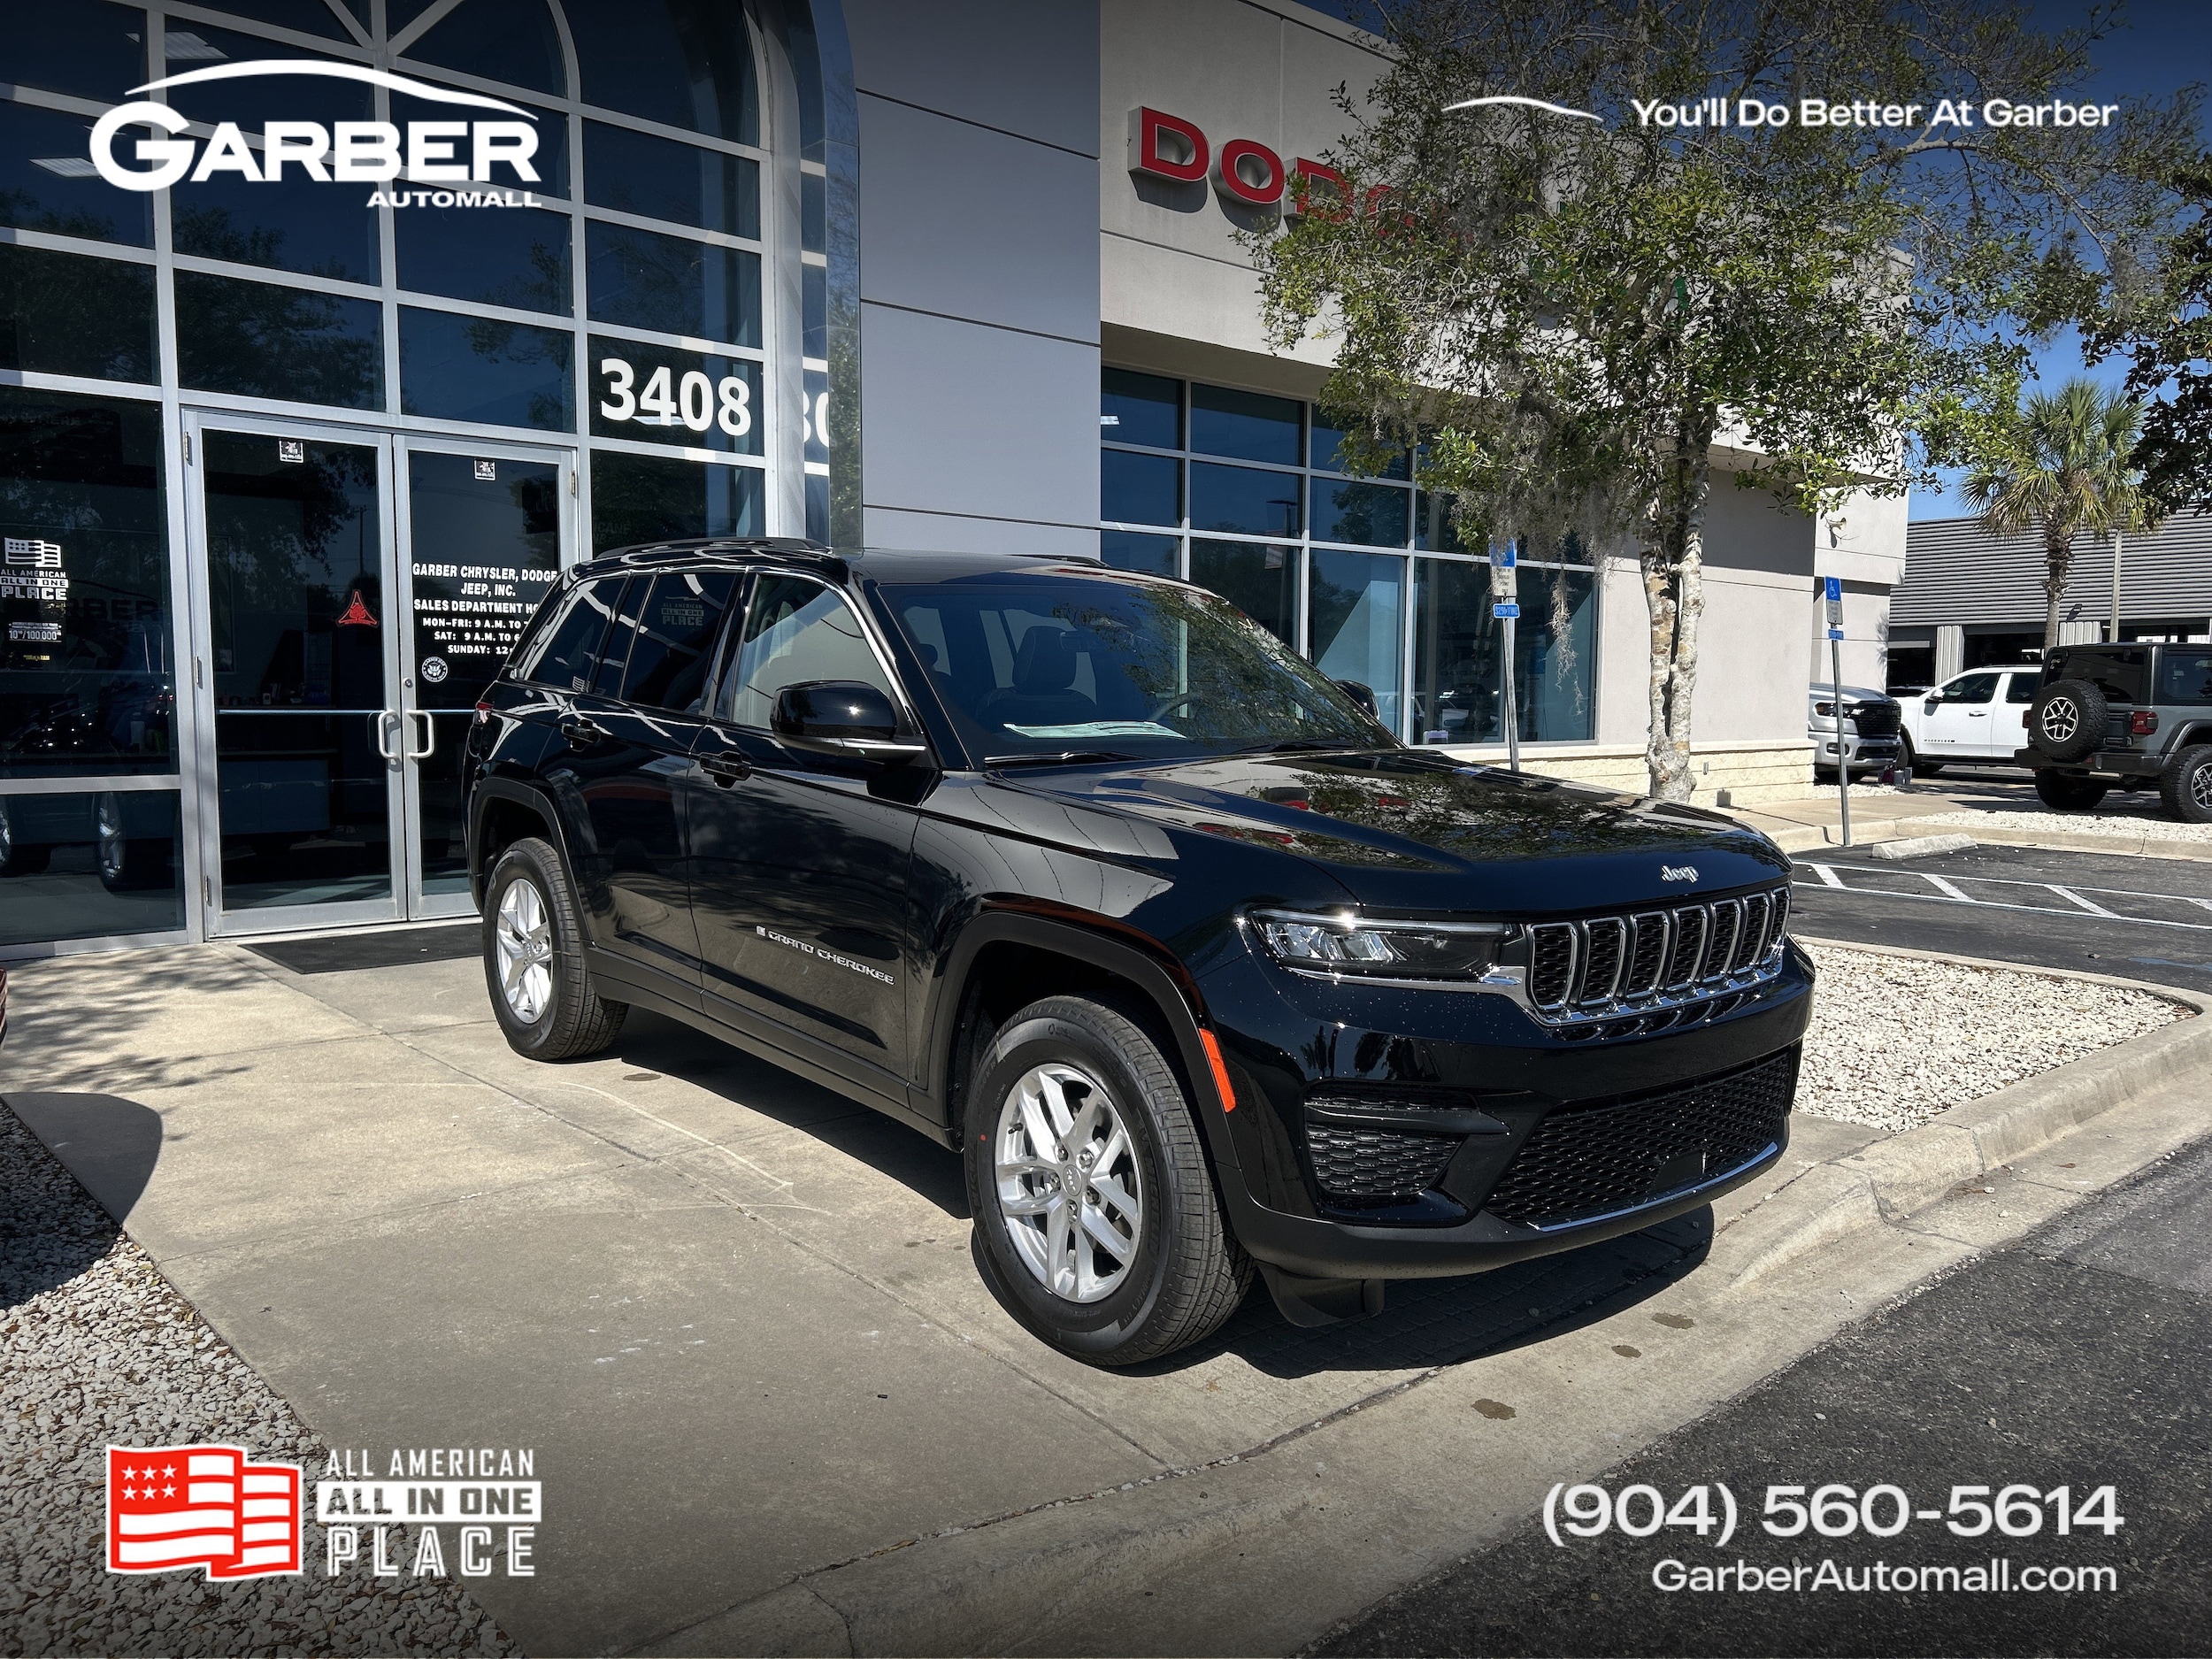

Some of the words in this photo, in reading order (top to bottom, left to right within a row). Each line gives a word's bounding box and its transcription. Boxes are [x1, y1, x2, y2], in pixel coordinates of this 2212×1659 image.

[601, 357, 751, 436] 3408
[412, 563, 457, 578] GARBER
[460, 565, 519, 582] CHRYSLER,
[2, 586, 67, 600] PLACE
[461, 582, 492, 597] JEEP,
[495, 584, 517, 597] INC.
[413, 599, 449, 611] SALES
[451, 600, 523, 614] DEPARTMENT
[423, 618, 472, 628] MON-FRI:
[663, 616, 703, 626] PLACE
[434, 632, 457, 641] SAT:
[473, 633, 495, 641] A.M.
[499, 633, 511, 641] TO
[448, 645, 490, 654] SUNDAY:
[1662, 865, 1699, 883] Jeep
[767, 931, 815, 954] GRAND
[817, 948, 895, 985] CHEROKEE
